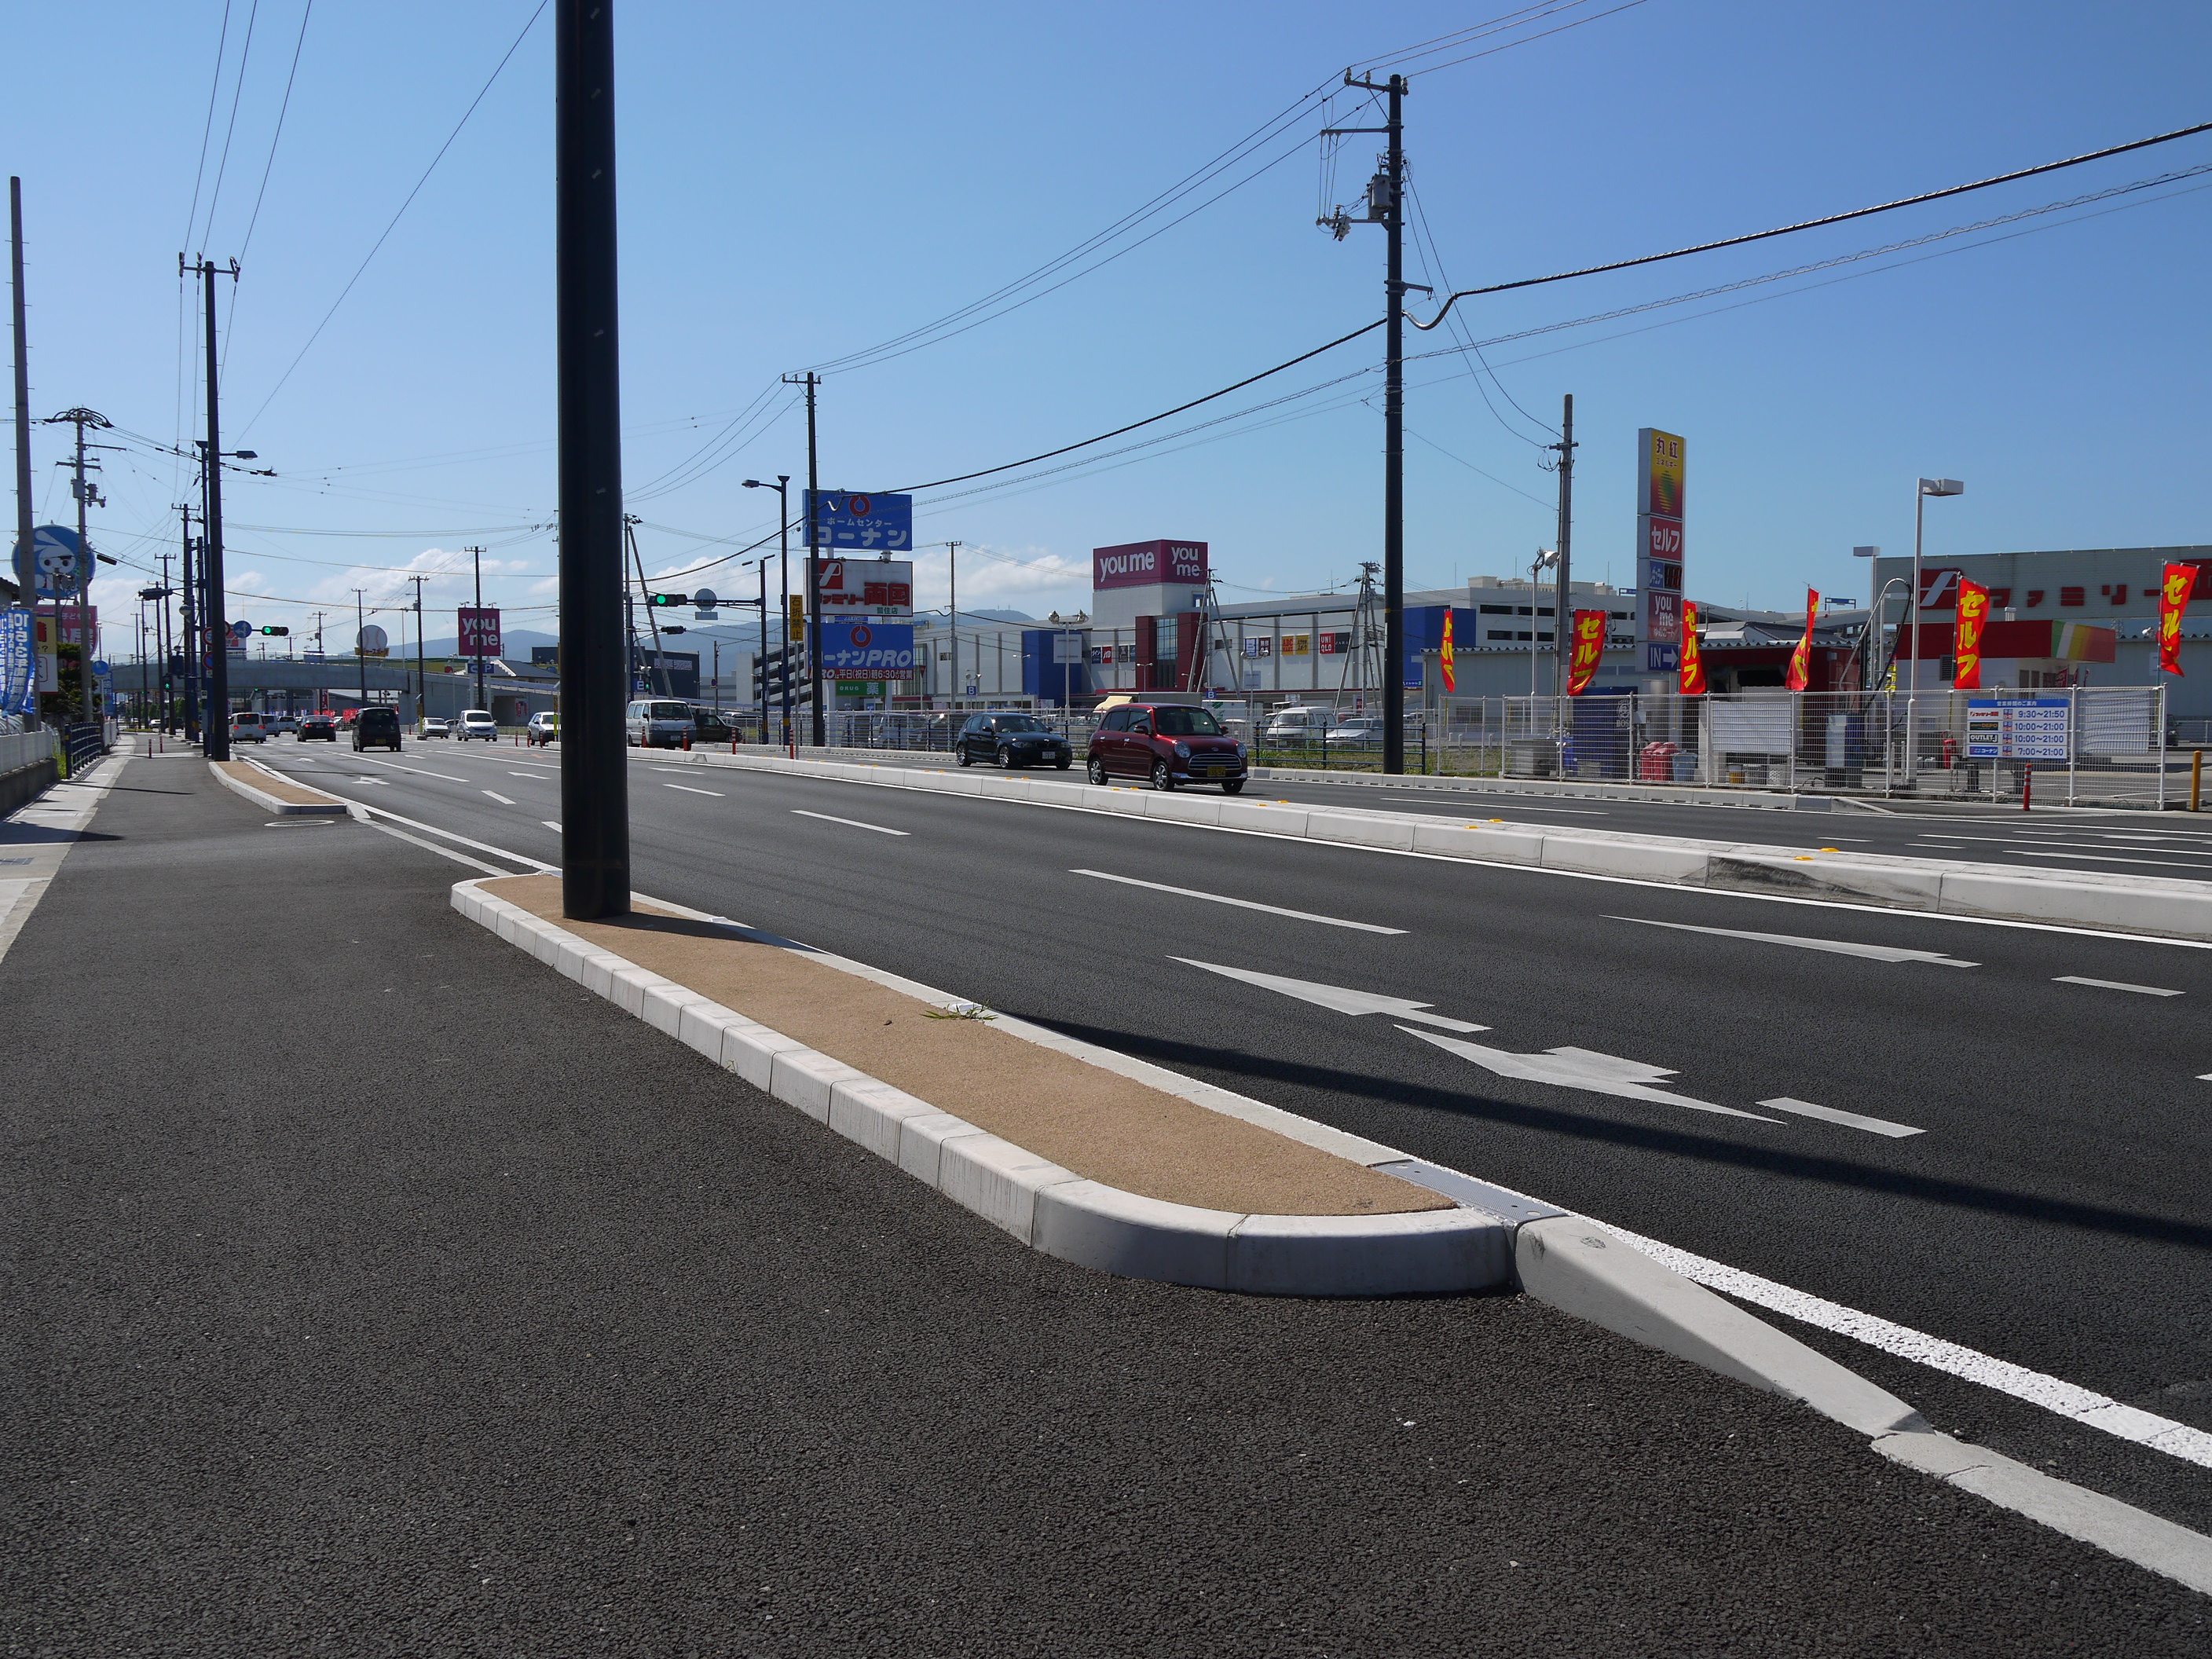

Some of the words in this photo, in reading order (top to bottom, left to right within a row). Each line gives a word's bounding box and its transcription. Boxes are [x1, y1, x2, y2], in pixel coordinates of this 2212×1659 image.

[1656, 437, 1679, 459] 丸紅
[827, 517, 892, 528] ホームセンター
[818, 526, 907, 547] コーナン
[1651, 526, 1680, 553] セルフ
[1171, 547, 1199, 565] you
[1100, 555, 1127, 583] you
[1130, 551, 1155, 572] me
[1176, 563, 1200, 577] me
[819, 582, 910, 606] ァミリー両国
[1654, 595, 1672, 615] you
[791, 596, 802, 640] 右折禁止
[1659, 611, 1674, 627] me
[469, 633, 499, 646] me
[1957, 591, 1986, 680] セルフ
[810, 649, 912, 668] ーナンPRO
[1320, 644, 1332, 653] QLO
[1573, 617, 1602, 690] セルフ
[1650, 646, 1661, 668] IN
[1684, 608, 1697, 689] セルフ
[485, 665, 492, 673] P
[866, 682, 879, 695] 薬
